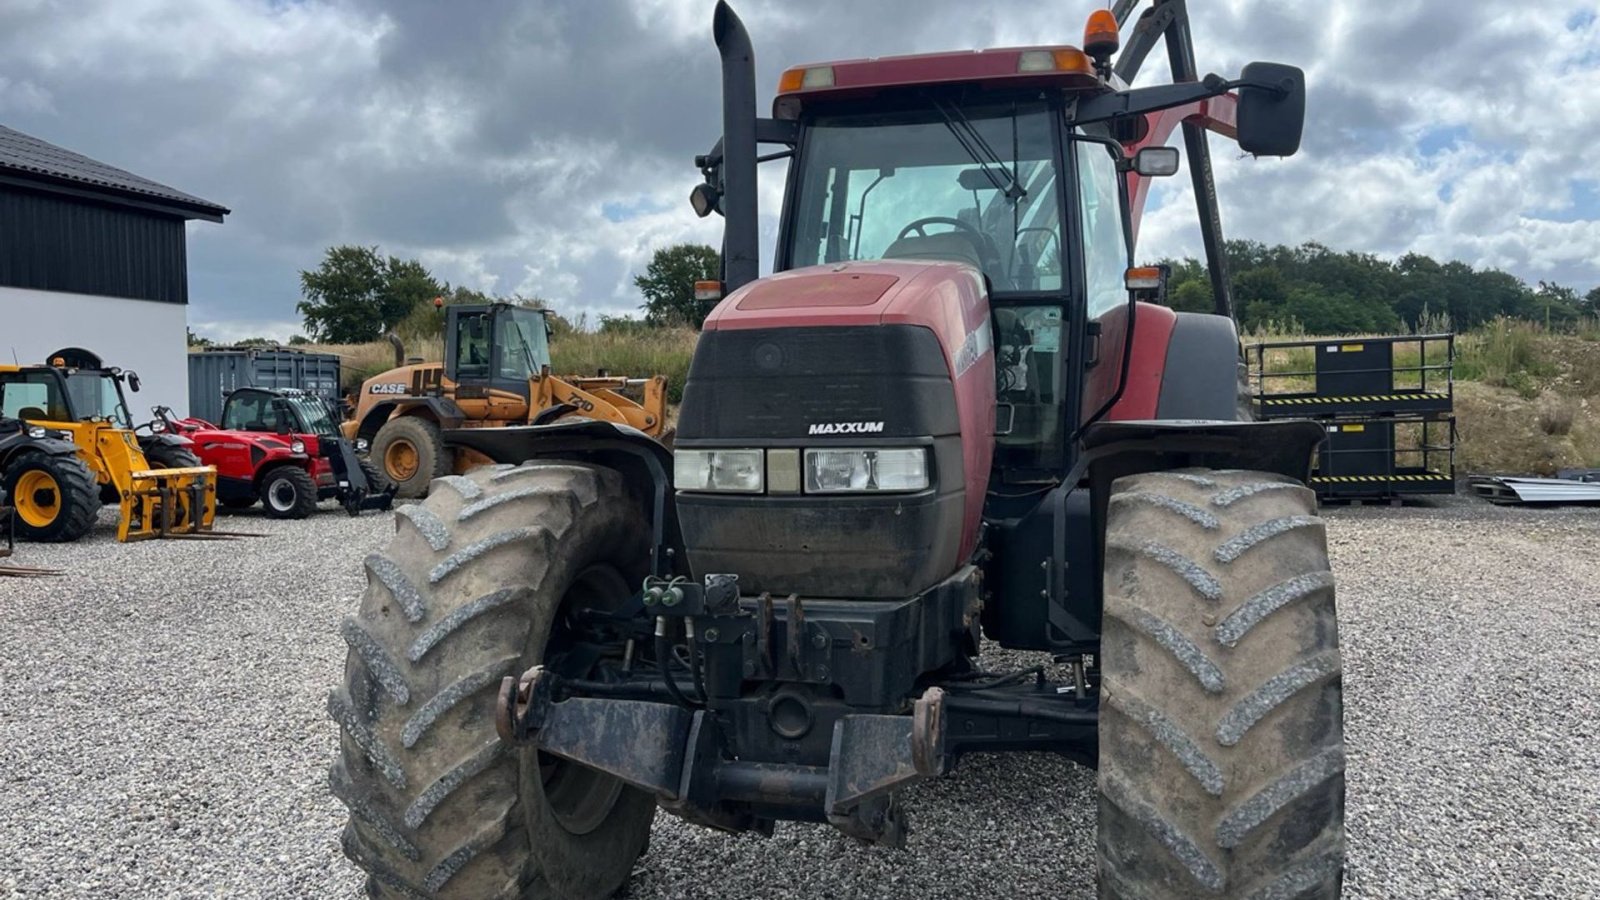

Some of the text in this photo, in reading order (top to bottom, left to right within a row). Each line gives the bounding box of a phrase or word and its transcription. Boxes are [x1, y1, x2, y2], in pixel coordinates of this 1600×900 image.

[372, 383, 406, 394] CASE
[568, 391, 595, 412] 721D
[808, 421, 885, 435] MAXXUM
